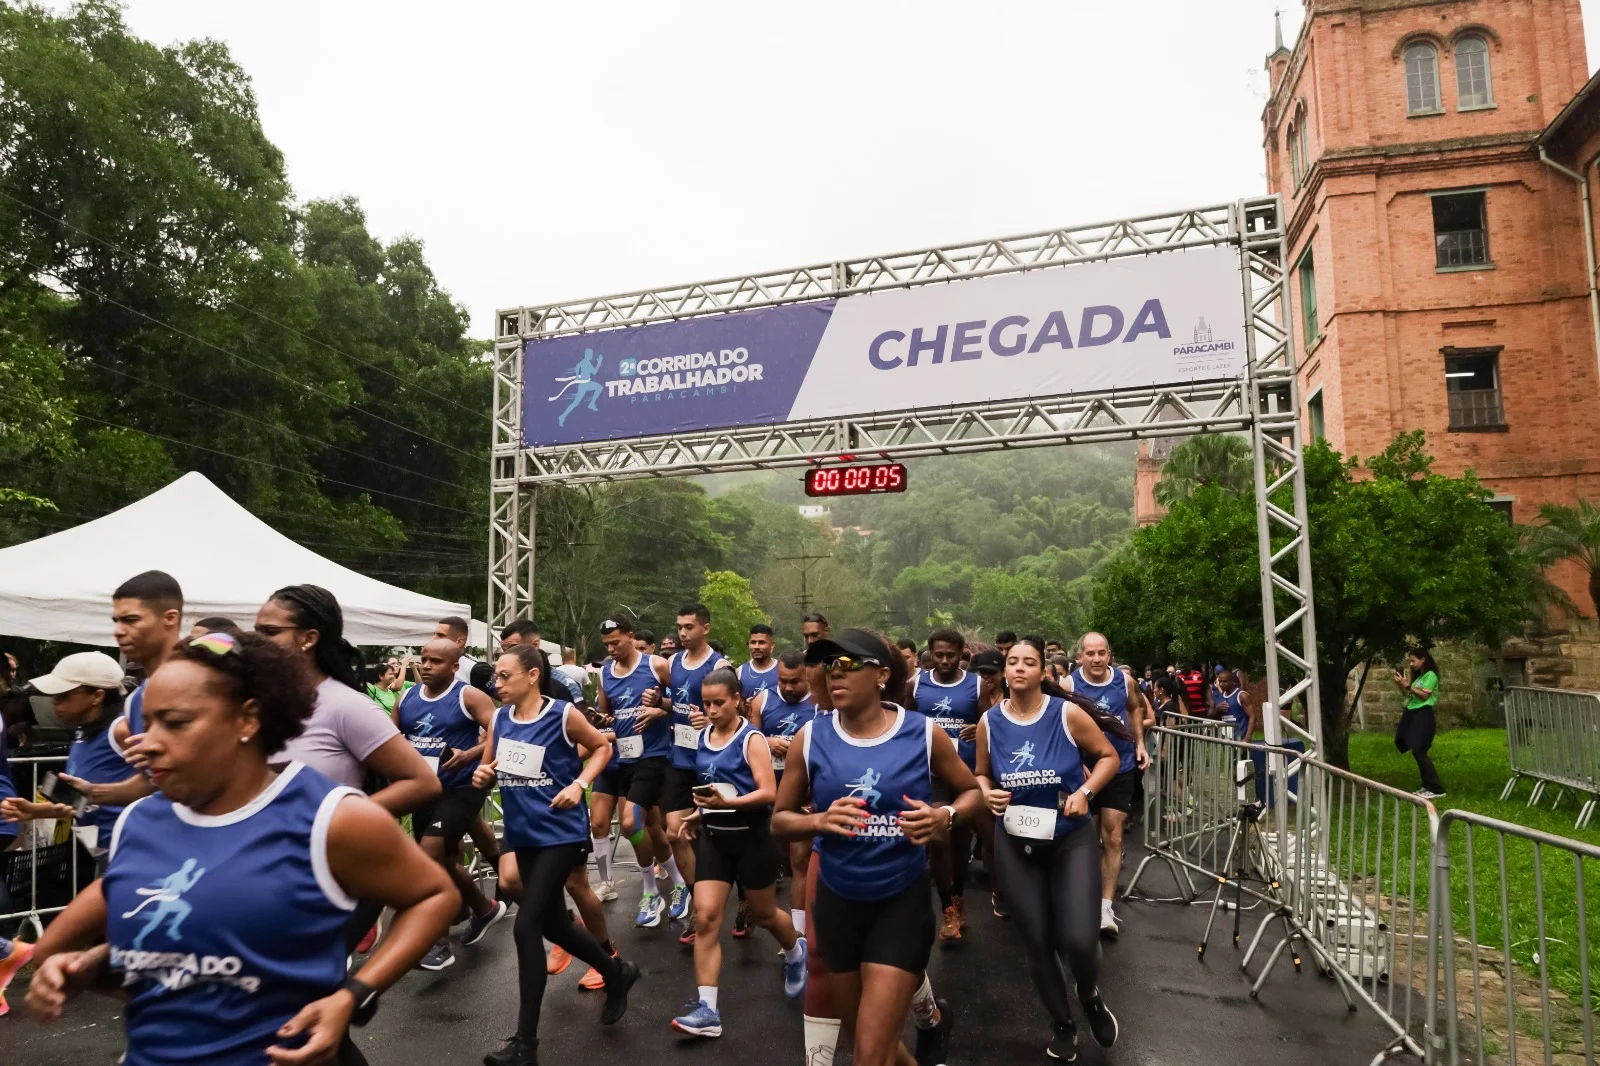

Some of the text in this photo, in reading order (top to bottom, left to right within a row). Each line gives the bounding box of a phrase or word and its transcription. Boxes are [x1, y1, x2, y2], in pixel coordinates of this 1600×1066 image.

[869, 298, 1171, 370] CHEGADA
[1173, 342, 1234, 355] PARACAMBI
[637, 352, 717, 375] CORRIDA
[720, 347, 748, 365] DO
[1178, 365, 1205, 373] ESPORTE
[605, 363, 763, 397] TRABALHADOR
[631, 385, 736, 404] PARACAMBI
[875, 466, 900, 487] 05
[506, 750, 527, 765] 302
[1000, 776, 1061, 788] RABALHADOR
[1006, 770, 1041, 780] CORRIDA
[1042, 769, 1055, 777] DO
[1017, 815, 1040, 827] 309
[201, 955, 242, 976] DO
